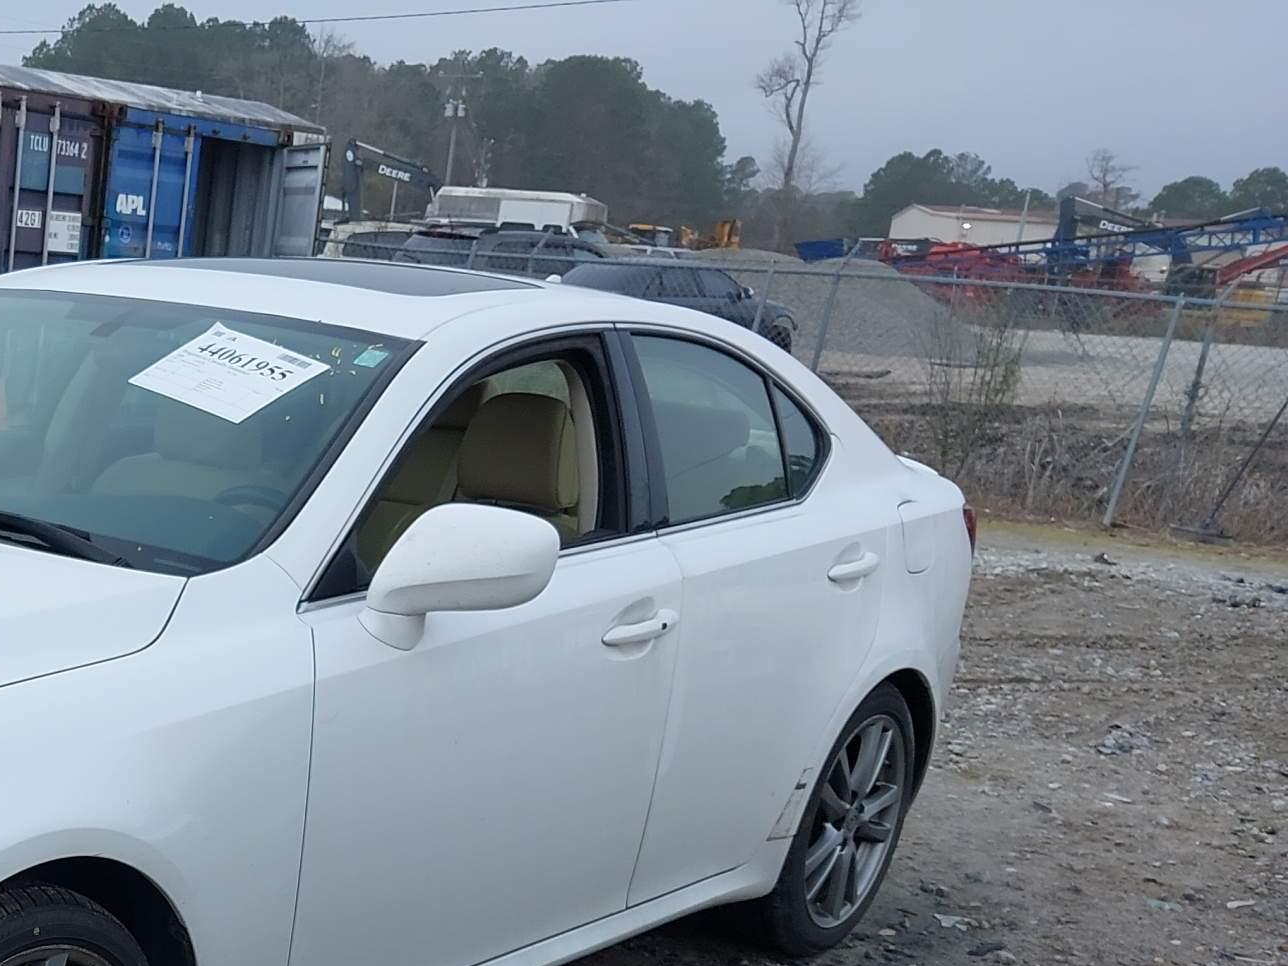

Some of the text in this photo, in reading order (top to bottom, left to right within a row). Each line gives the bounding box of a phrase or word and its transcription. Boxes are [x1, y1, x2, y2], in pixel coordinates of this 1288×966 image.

[30, 135, 48, 152] TCLU
[378, 164, 412, 182] DEERE
[116, 193, 146, 216] APL
[198, 343, 294, 382] 44061955
